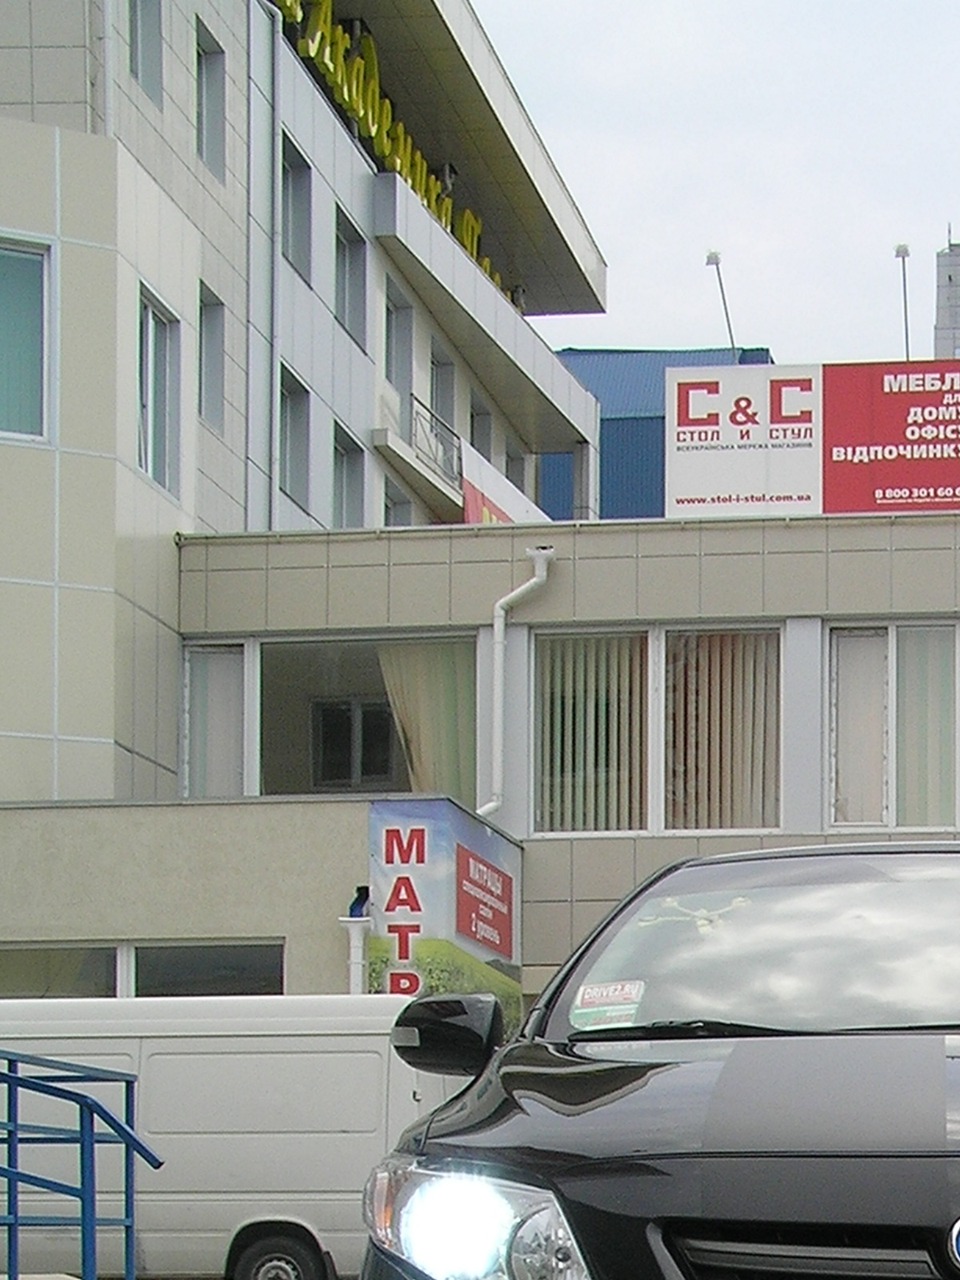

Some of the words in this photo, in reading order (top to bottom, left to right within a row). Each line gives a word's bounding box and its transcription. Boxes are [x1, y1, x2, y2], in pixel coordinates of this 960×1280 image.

[676, 430, 720, 443] СТОЛ
[740, 429, 750, 440] И
[769, 428, 813, 440] СТУЛ
[911, 487, 935, 498] 301
[937, 486, 954, 497] 60
[675, 494, 811, 505] www.stol-i-stul.com.ua
